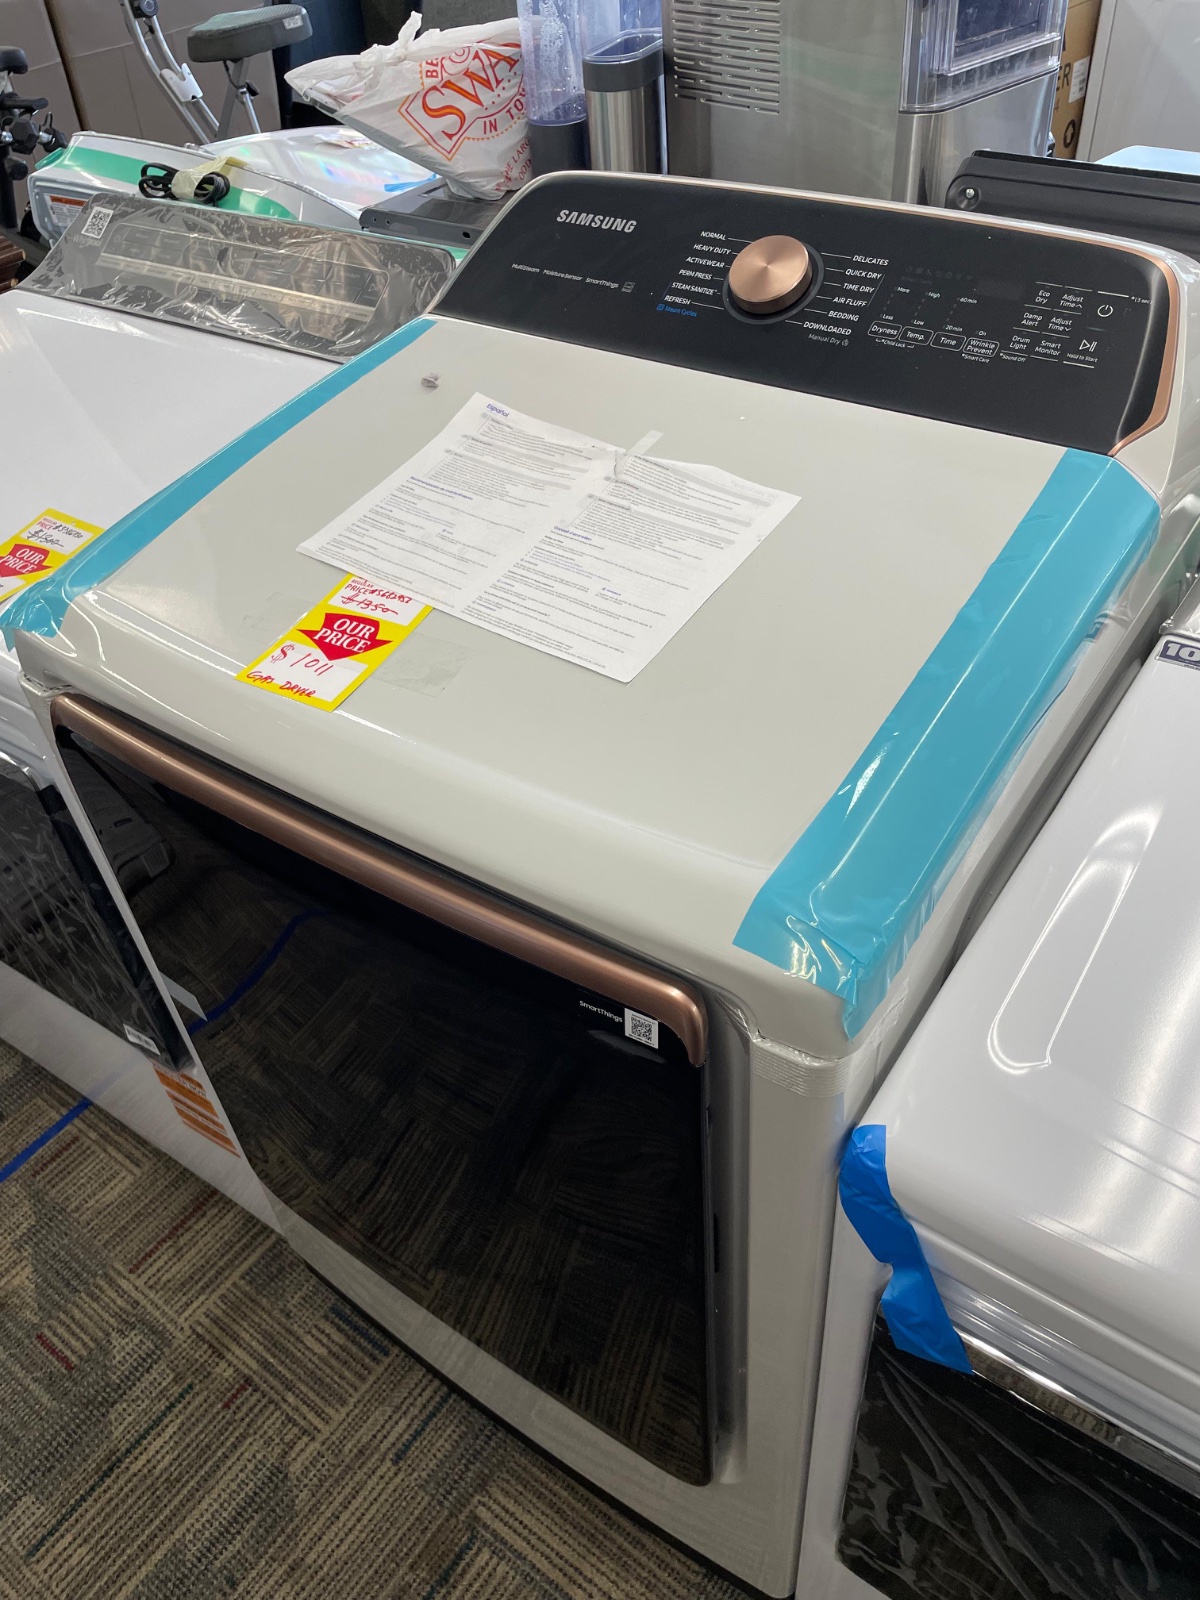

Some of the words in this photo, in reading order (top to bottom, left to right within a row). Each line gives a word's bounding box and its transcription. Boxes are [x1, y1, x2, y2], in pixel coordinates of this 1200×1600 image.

[425, 57, 440, 79] BE
[421, 49, 521, 142] SWA
[483, 118, 498, 135] IN
[556, 209, 637, 233] SAMSUNG
[700, 231, 726, 241] NORMAL
[693, 243, 714, 252] HEAVY
[713, 247, 732, 255] DUTY
[685, 256, 725, 268] ACTIVEWEAR
[852, 255, 889, 266] DELICATES
[678, 269, 696, 278] PERM
[694, 271, 713, 280] PRESS
[845, 268, 867, 278] QUICK
[866, 272, 882, 280] DRY
[585, 277, 619, 289] SmartThings
[671, 281, 691, 291] STEAM
[843, 282, 859, 291] TIME
[859, 285, 875, 294] DRY
[897, 286, 911, 294] More
[928, 291, 941, 299] High
[1038, 289, 1051, 298] Eco
[664, 294, 691, 305] REFRESH
[832, 296, 846, 304] AIR
[845, 298, 868, 307] FLUFF
[1035, 296, 1048, 304] Dry
[1061, 293, 1084, 302] Adjust
[1059, 300, 1076, 308] Time
[664, 305, 681, 314] Steam
[680, 308, 698, 317] Cycles
[828, 310, 860, 322] BEDDING
[1023, 312, 1043, 321] Damp
[1021, 319, 1039, 327] Alert
[1047, 323, 1064, 331] Time
[1050, 317, 1073, 326] Adjust
[803, 321, 852, 336] DOWNLOADED
[871, 324, 898, 336] Dryness
[808, 333, 829, 343] Manual
[829, 336, 841, 346] Dry
[906, 331, 925, 340] Temp.
[1012, 335, 1031, 343] Drum
[940, 337, 957, 346] Time
[969, 339, 996, 350] Wrinkle
[1009, 341, 1027, 350] Light
[1040, 340, 1061, 349] Smart
[966, 345, 993, 356] Prevent
[1034, 346, 1060, 356] Monitor
[1084, 355, 1098, 363] Start
[486, 403, 510, 417] Español
[15, 548, 45, 565] OUR
[1, 554, 37, 574] PRICE
[344, 583, 370, 595] PRICE
[333, 618, 376, 640] OUR
[313, 627, 372, 653] PRICE
[579, 1000, 623, 1023] SmartThings
